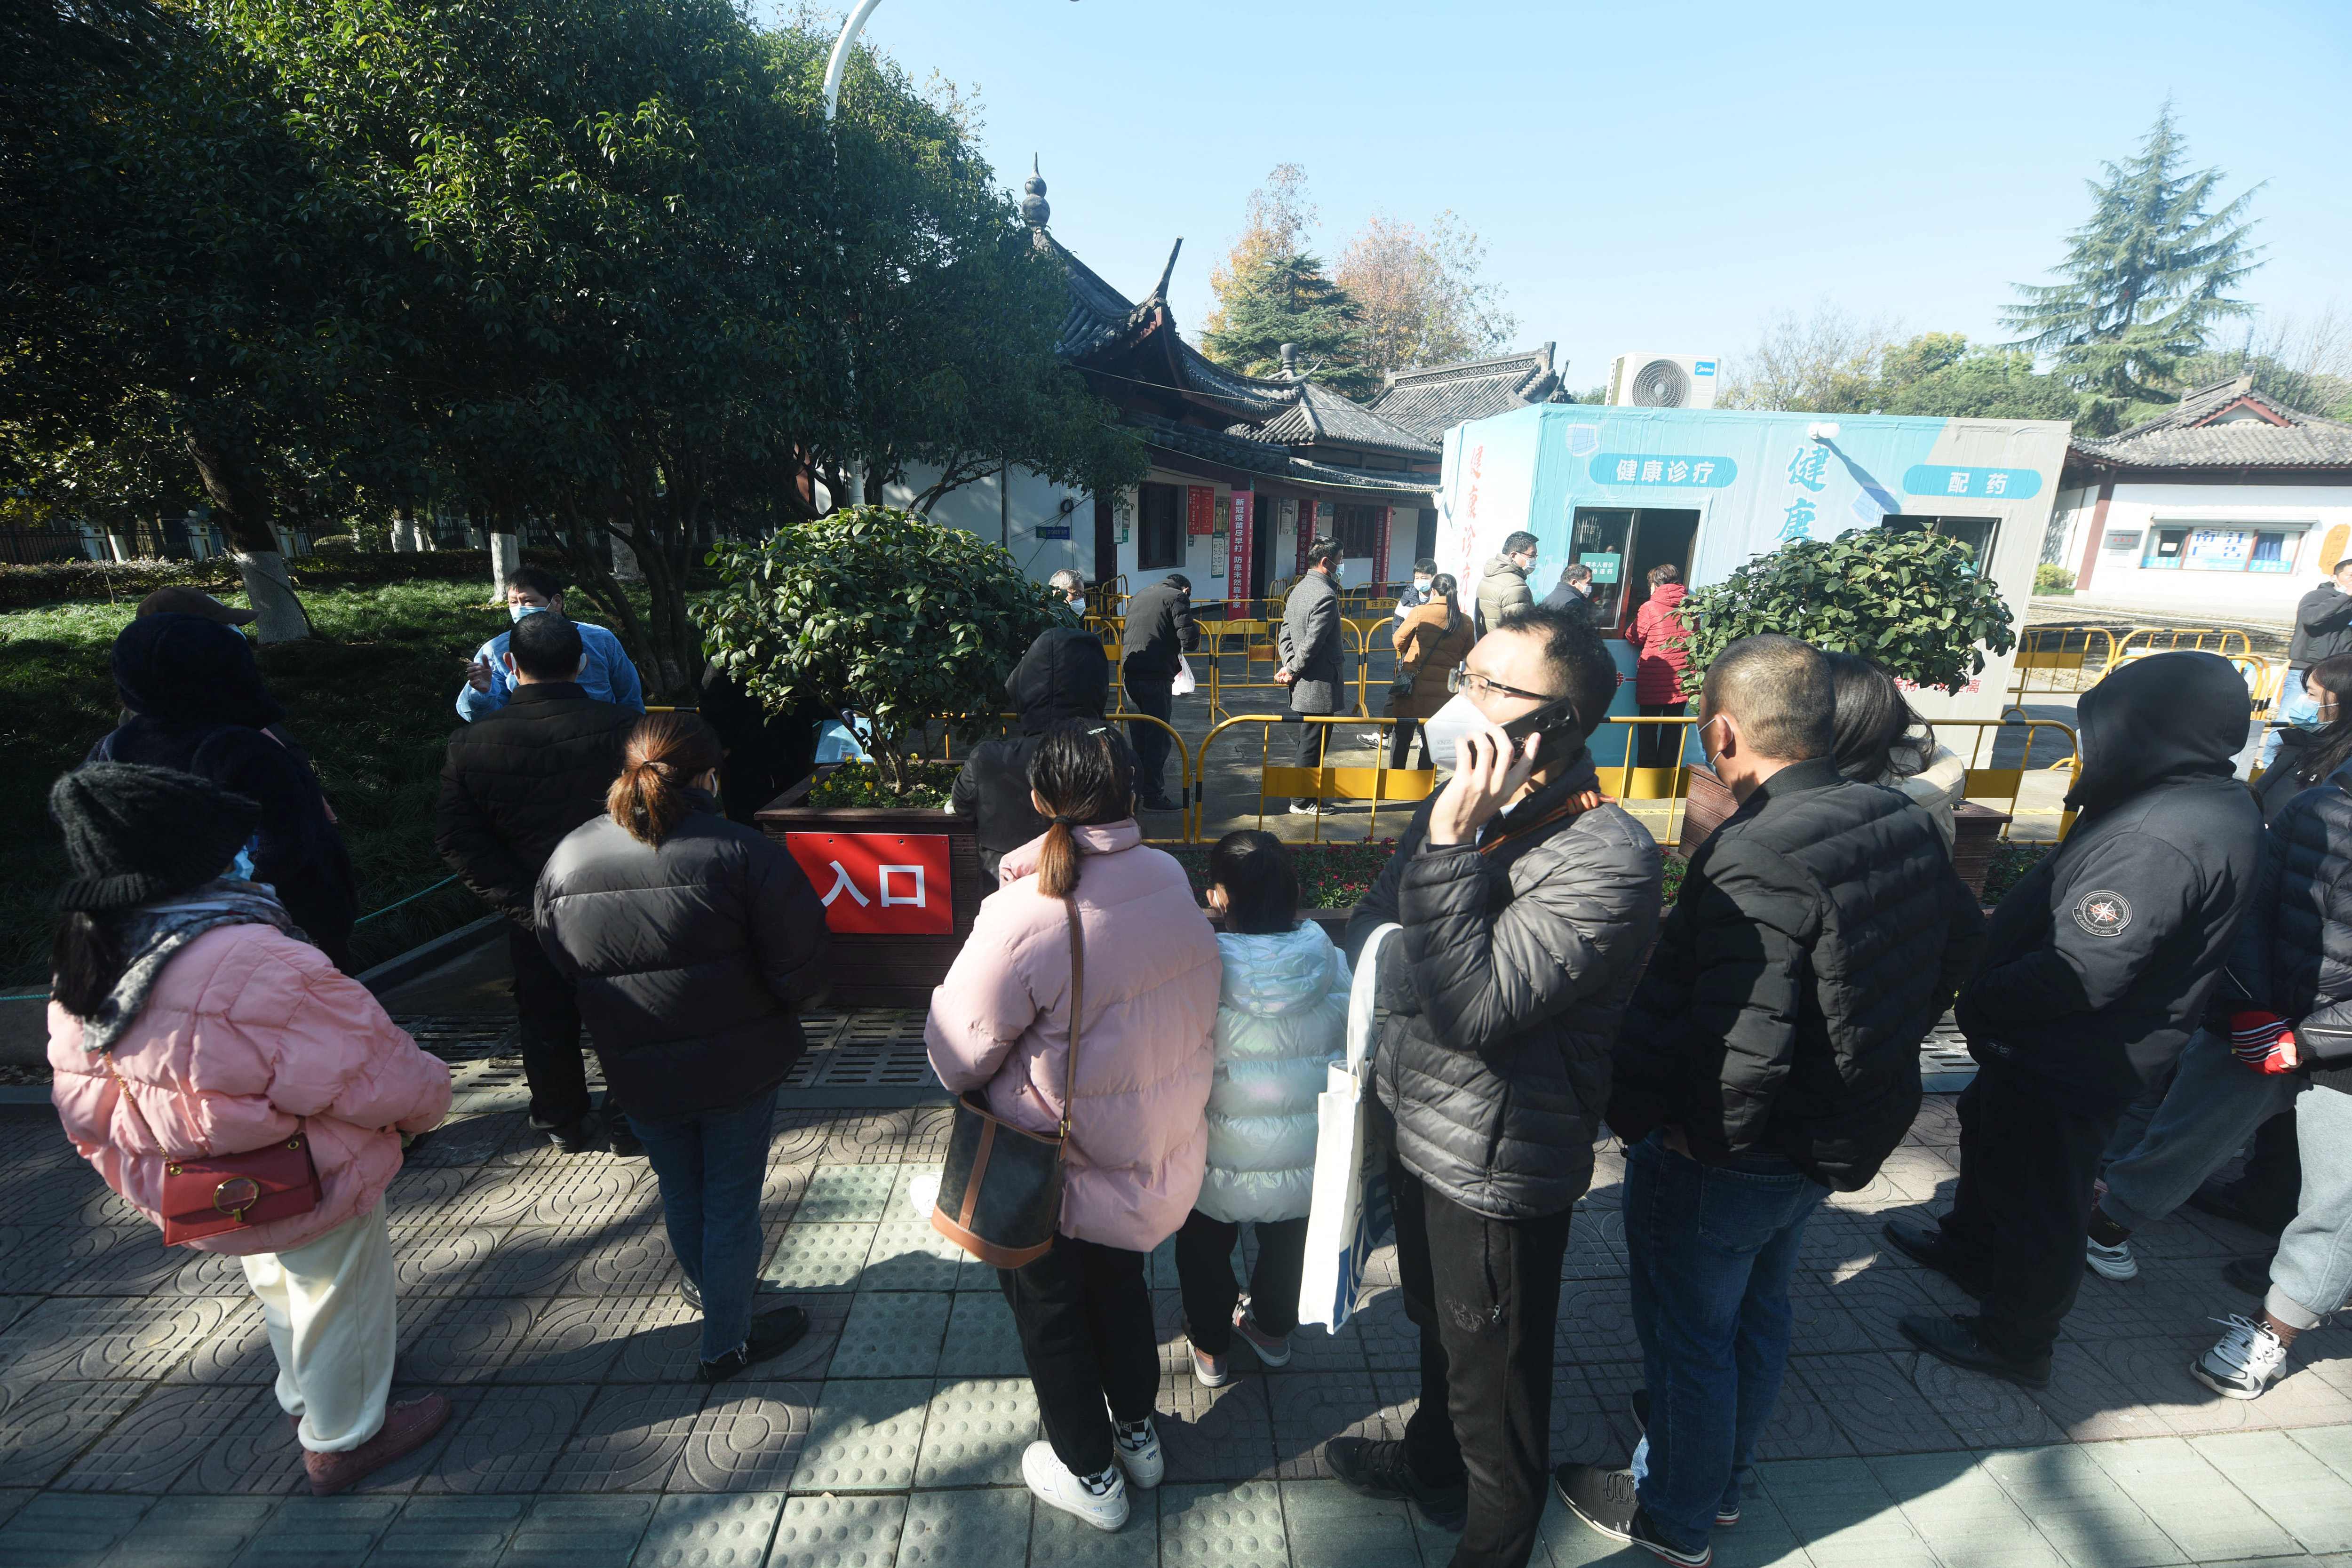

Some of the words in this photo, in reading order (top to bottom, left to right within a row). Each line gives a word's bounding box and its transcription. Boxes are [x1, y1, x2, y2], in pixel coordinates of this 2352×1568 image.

[1616, 459, 1715, 484] 健康诊疗
[1947, 471, 2009, 494] 配药
[1234, 498, 1245, 552] 新冠疫苗尽早打
[1232, 556, 1243, 608] 防患未然靠大家
[821, 860, 926, 907] 入口
